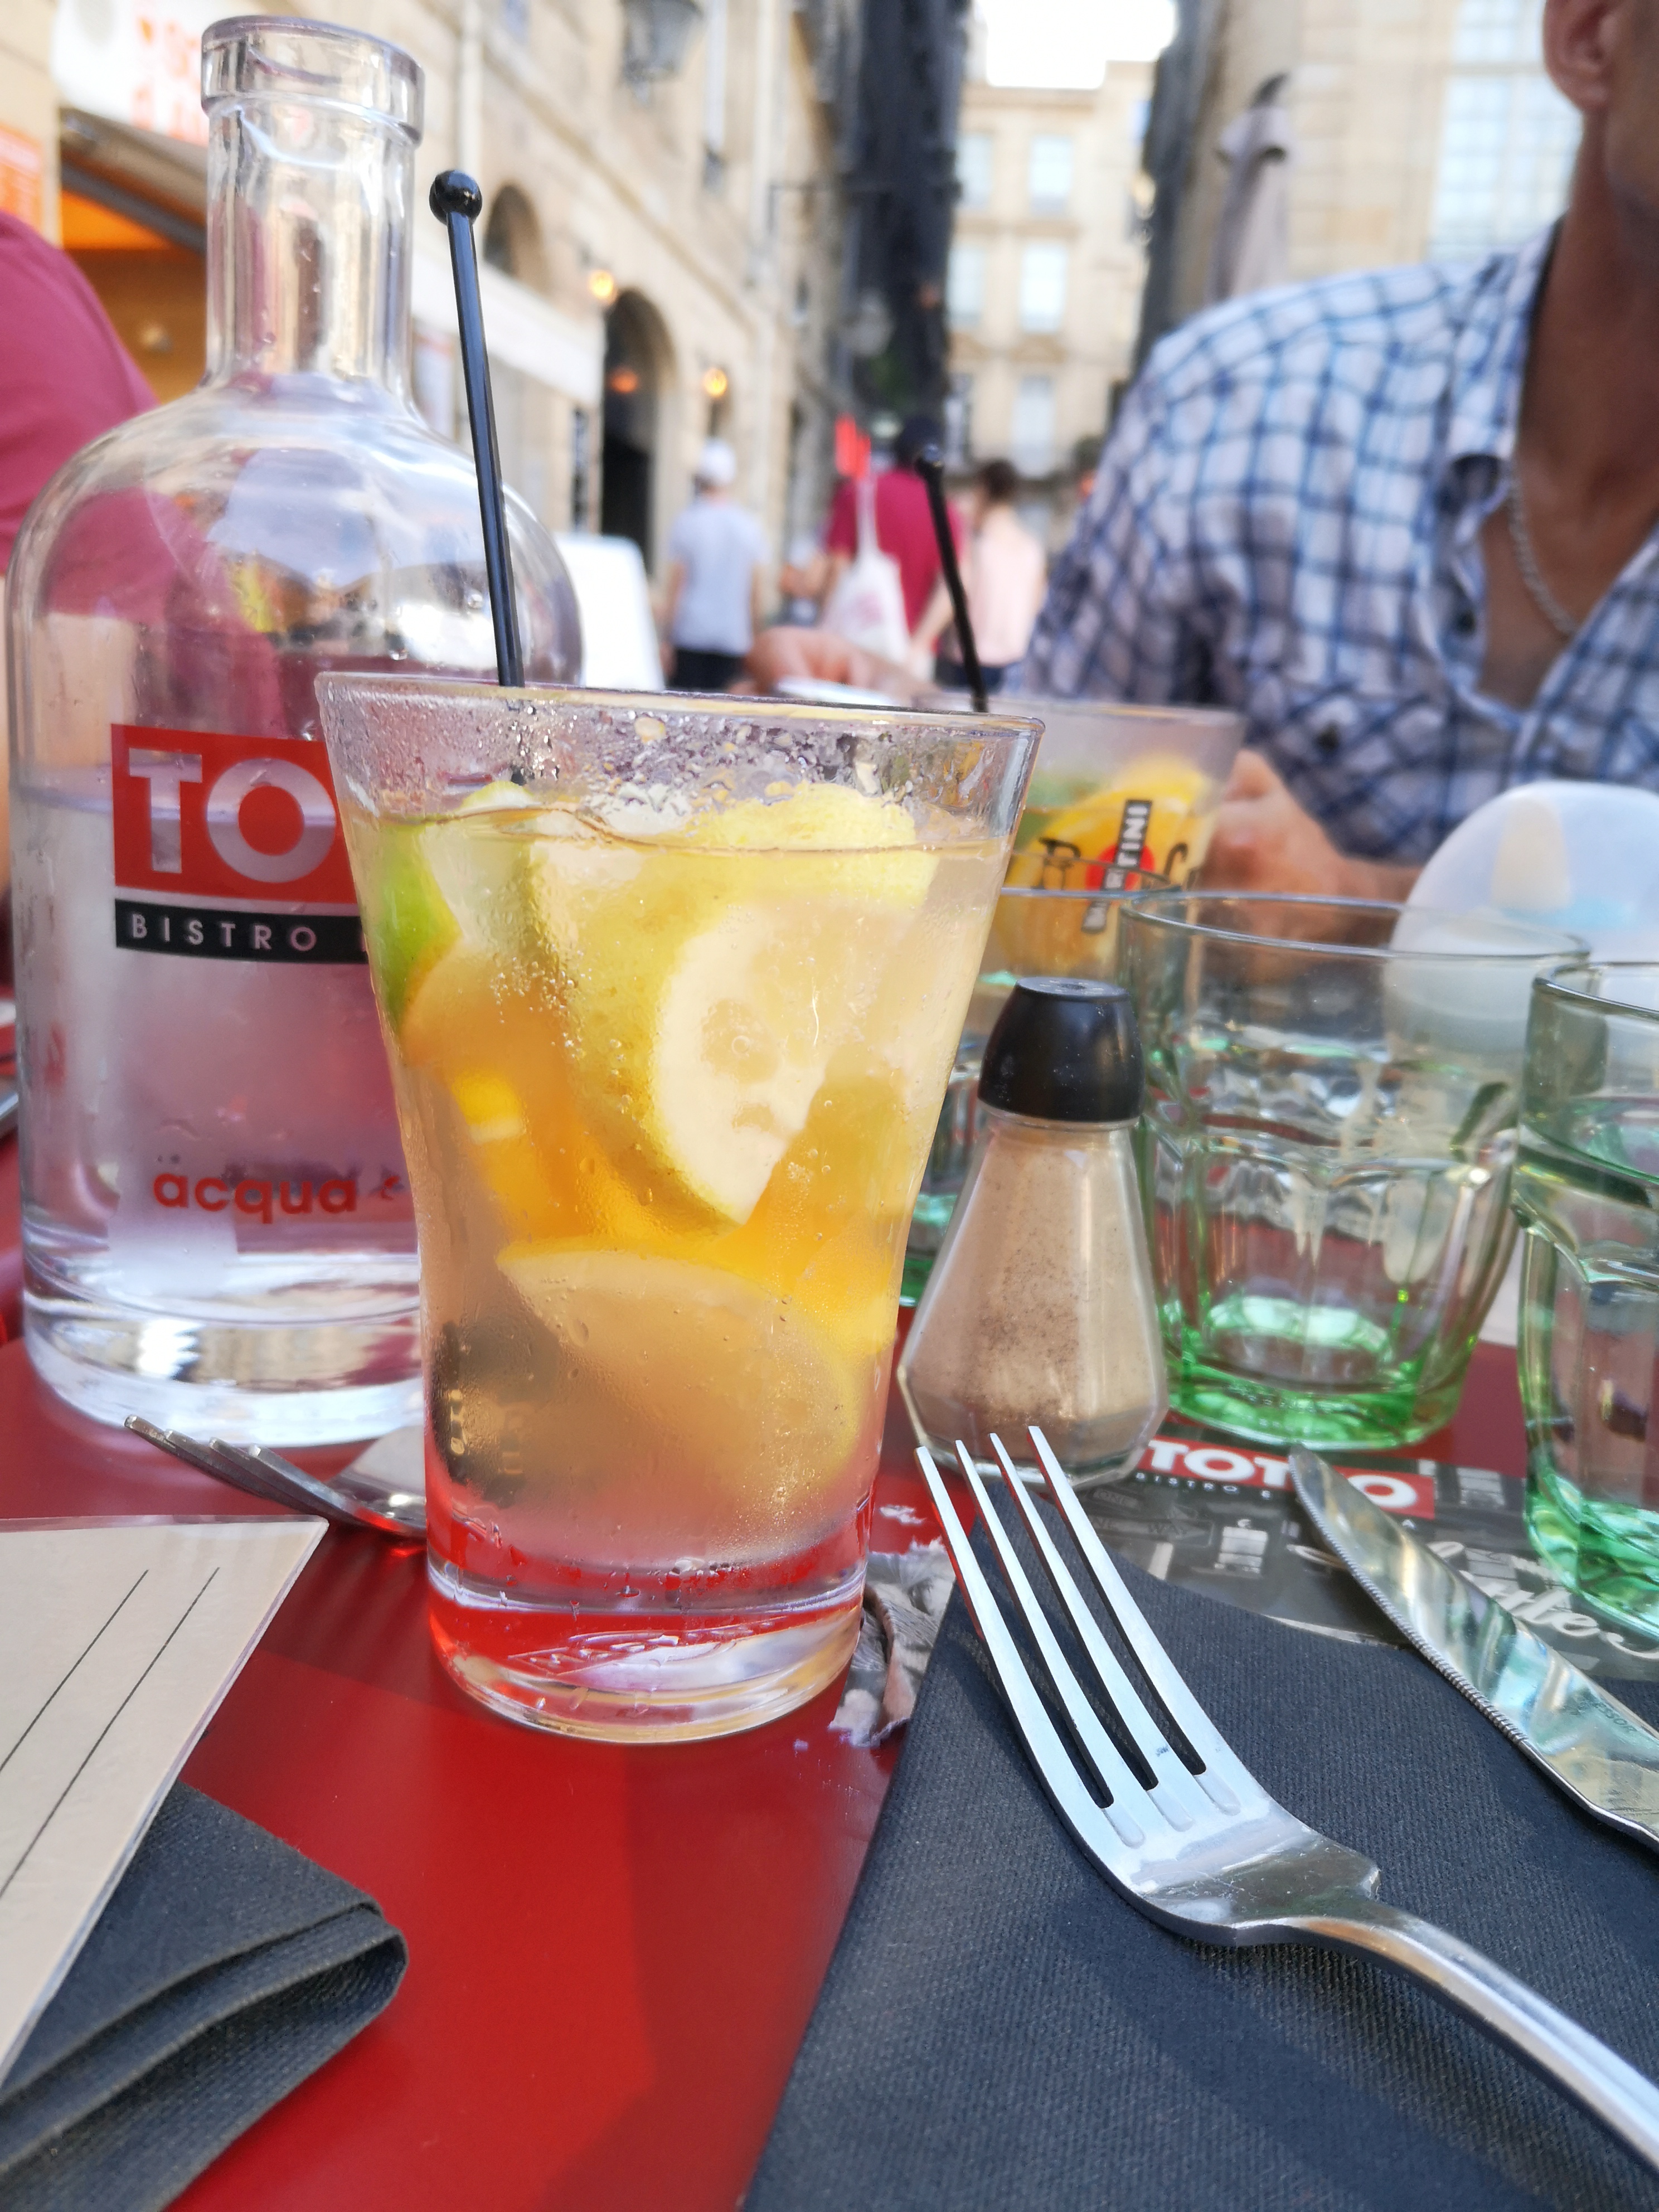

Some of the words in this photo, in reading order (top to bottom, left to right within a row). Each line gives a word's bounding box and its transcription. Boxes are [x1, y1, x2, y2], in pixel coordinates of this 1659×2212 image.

[129, 748, 337, 884] TO
[132, 914, 317, 951] BISTRO
[153, 1173, 357, 1224] acqua
[1136, 1472, 1239, 1494] BISTRO
